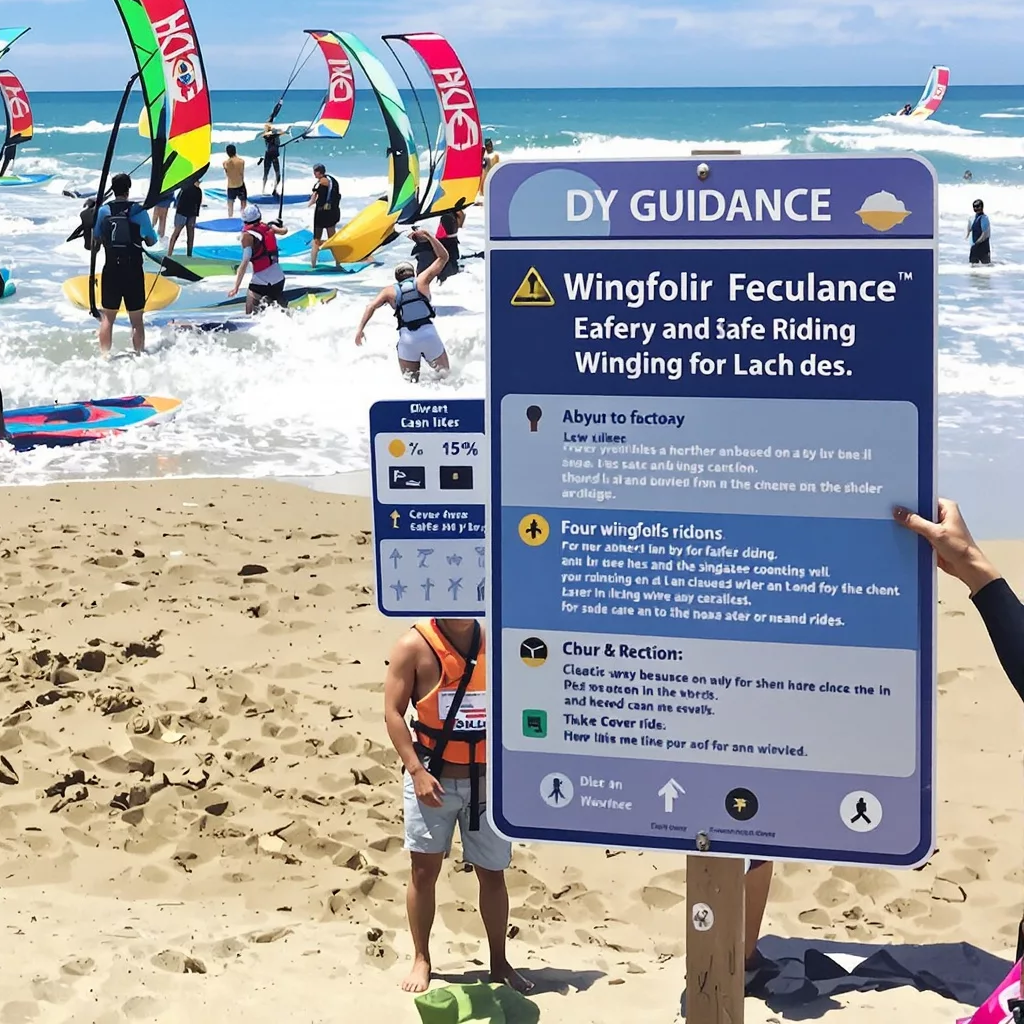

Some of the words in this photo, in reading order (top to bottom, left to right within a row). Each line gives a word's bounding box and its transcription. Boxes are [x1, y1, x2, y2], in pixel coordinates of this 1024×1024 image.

[566, 189, 618, 222] DY
[629, 188, 832, 223] GUIDANCE
[563, 272, 712, 308] Wingfolir
[575, 317, 656, 344] Eafery
[662, 317, 709, 340] and
[773, 319, 856, 347] Riding
[575, 351, 680, 379] Winding
[689, 352, 725, 376] for
[611, 412, 626, 424] to
[561, 520, 597, 535] Four
[651, 559, 673, 570] and
[655, 606, 666, 617] to
[604, 644, 615, 657] &
[735, 677, 752, 687] for
[564, 697, 586, 706] and
